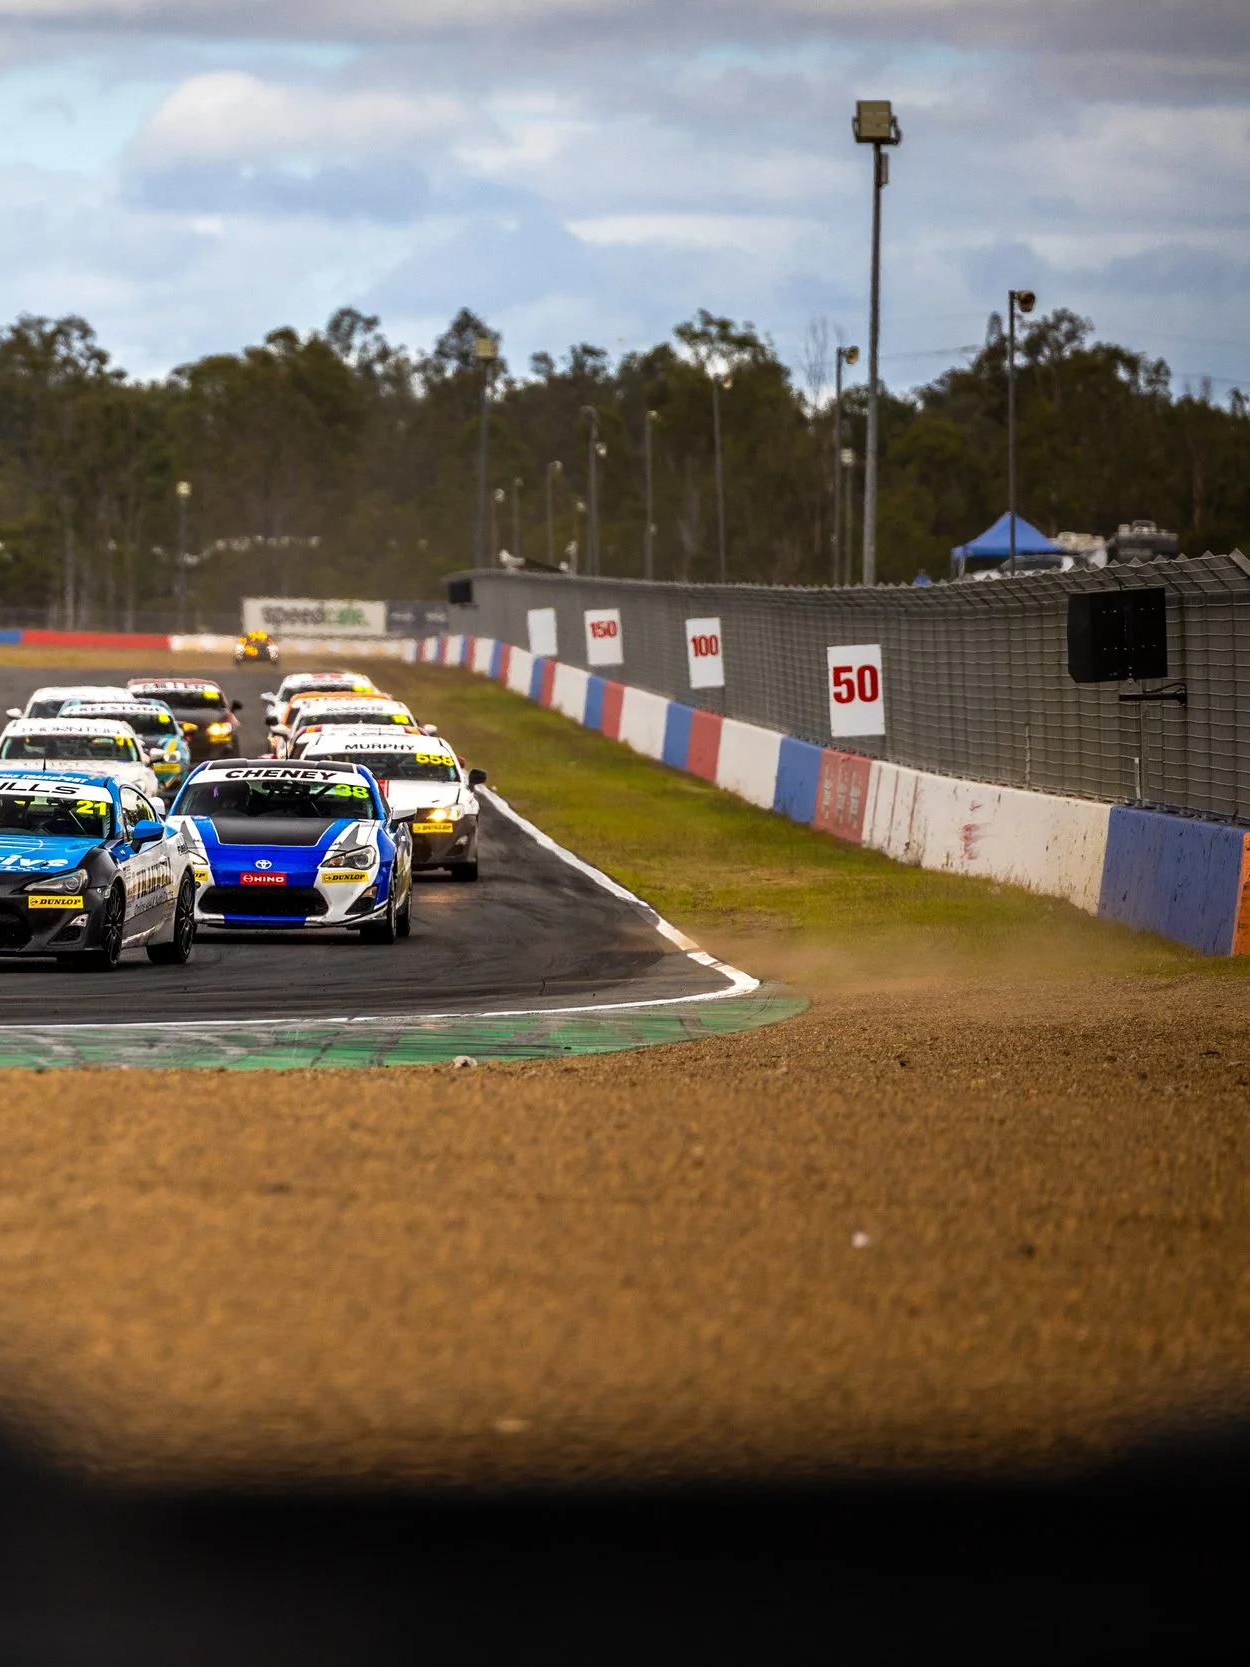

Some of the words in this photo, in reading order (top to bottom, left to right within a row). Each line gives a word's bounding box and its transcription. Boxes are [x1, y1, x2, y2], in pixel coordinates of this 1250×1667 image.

[589, 620, 618, 638] 150
[690, 634, 719, 657] 100
[833, 664, 879, 704] 50
[344, 743, 415, 751] MURPHY
[415, 753, 455, 767] 558
[225, 769, 337, 781] CHENEY
[334, 784, 370, 799] 38
[76, 800, 108, 816] 21
[253, 875, 285, 883] HINO
[331, 873, 366, 882] DUNLOP
